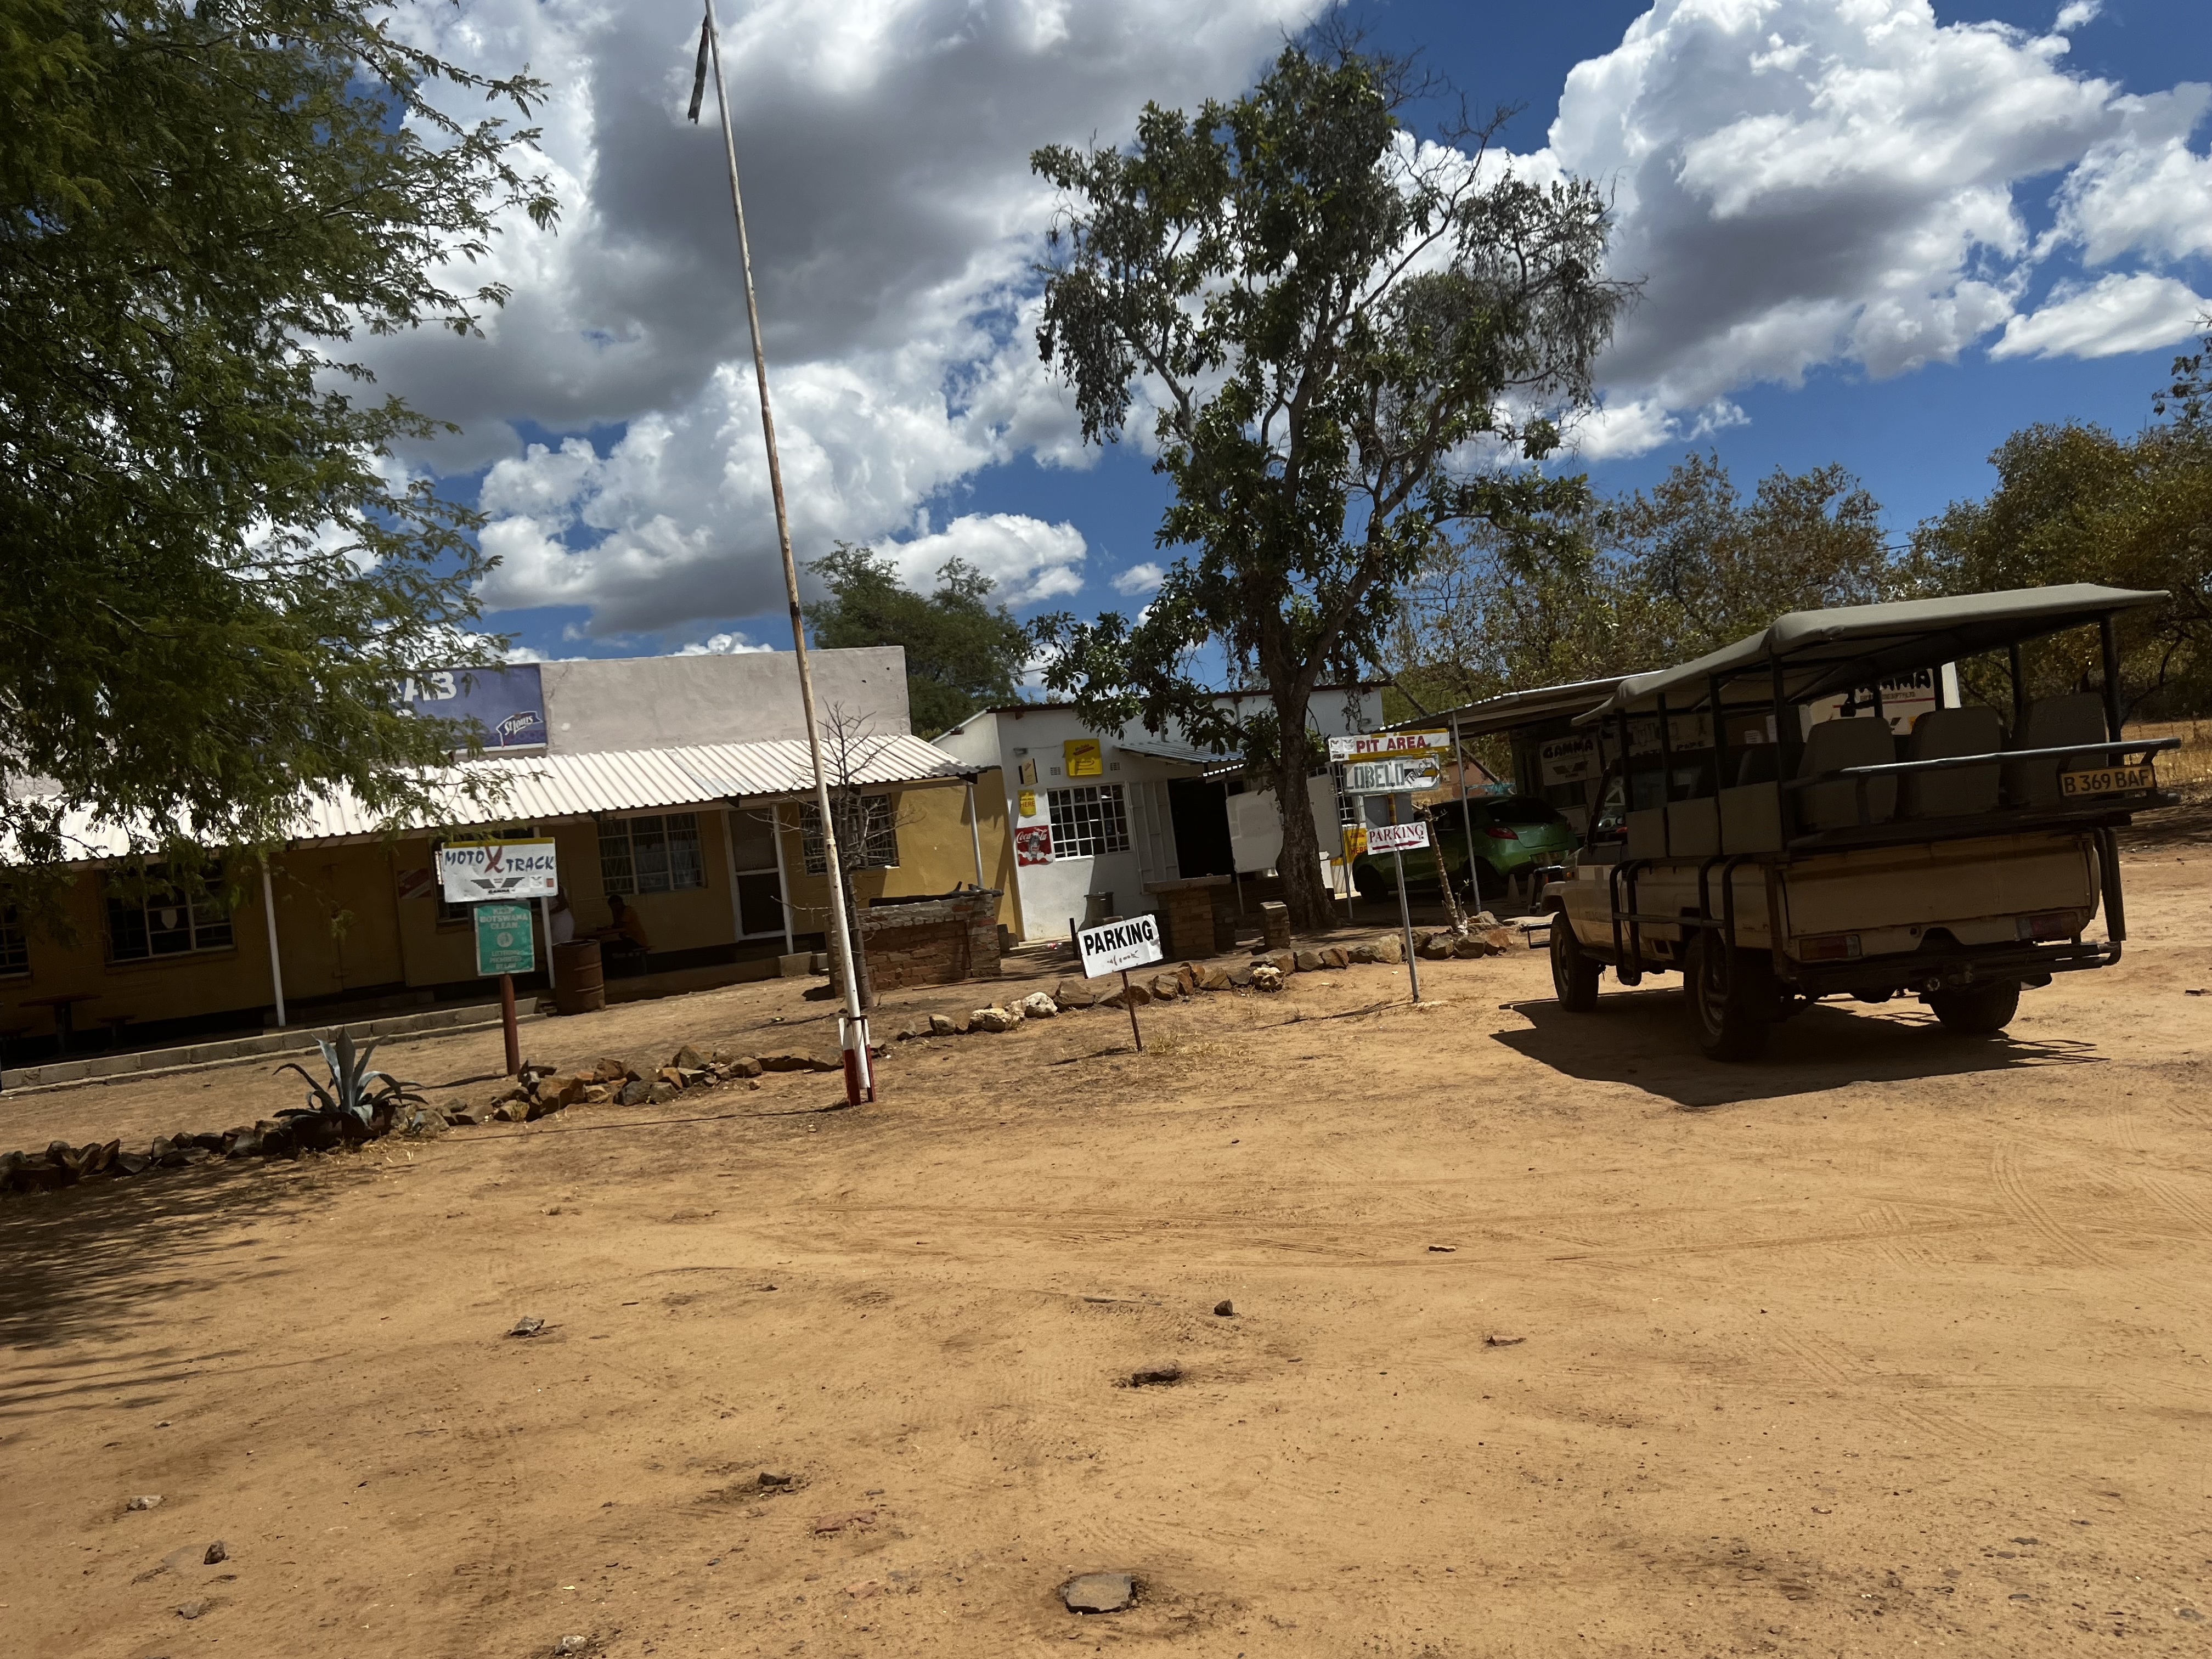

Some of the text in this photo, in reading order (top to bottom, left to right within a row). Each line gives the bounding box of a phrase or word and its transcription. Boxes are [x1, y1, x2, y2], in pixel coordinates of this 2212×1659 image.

[512, 715, 533, 735] Louis
[1356, 739, 1379, 753] PIT
[1387, 736, 1427, 751] AREA
[1543, 739, 1594, 759] GAMMA
[2064, 769, 2150, 793] B 369 BAF
[1369, 823, 1424, 843] PARKING
[445, 845, 555, 873] MOTO X TRACK
[479, 913, 528, 923] BOTSWANA
[1083, 920, 1153, 956] PARKING
